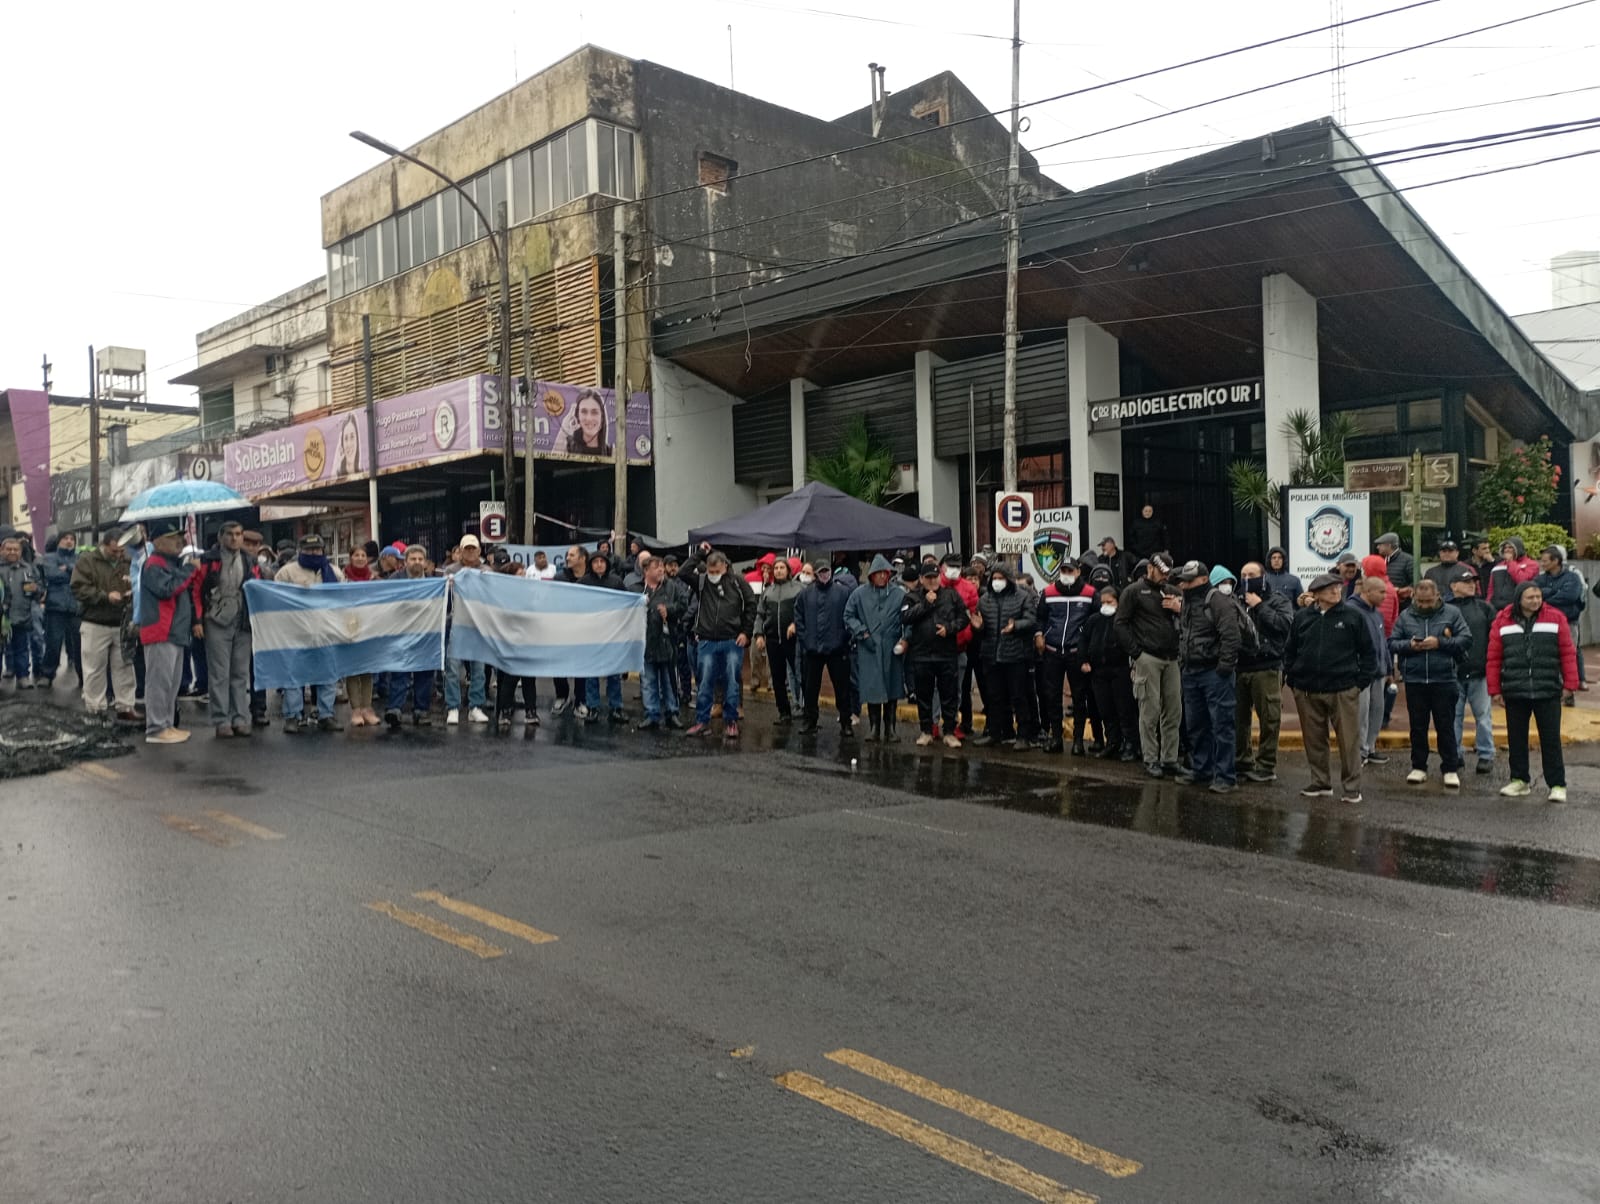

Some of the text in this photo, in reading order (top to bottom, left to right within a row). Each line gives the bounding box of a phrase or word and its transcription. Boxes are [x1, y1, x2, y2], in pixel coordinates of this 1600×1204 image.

[1231, 385, 1251, 403] UR
[1254, 382, 1260, 400] I
[1372, 464, 1402, 474] Uruguay
[1320, 493, 1329, 501] DE
[1332, 491, 1368, 501] MISIONES
[1007, 501, 1022, 527] E
[1034, 511, 1073, 524] OLICIA
